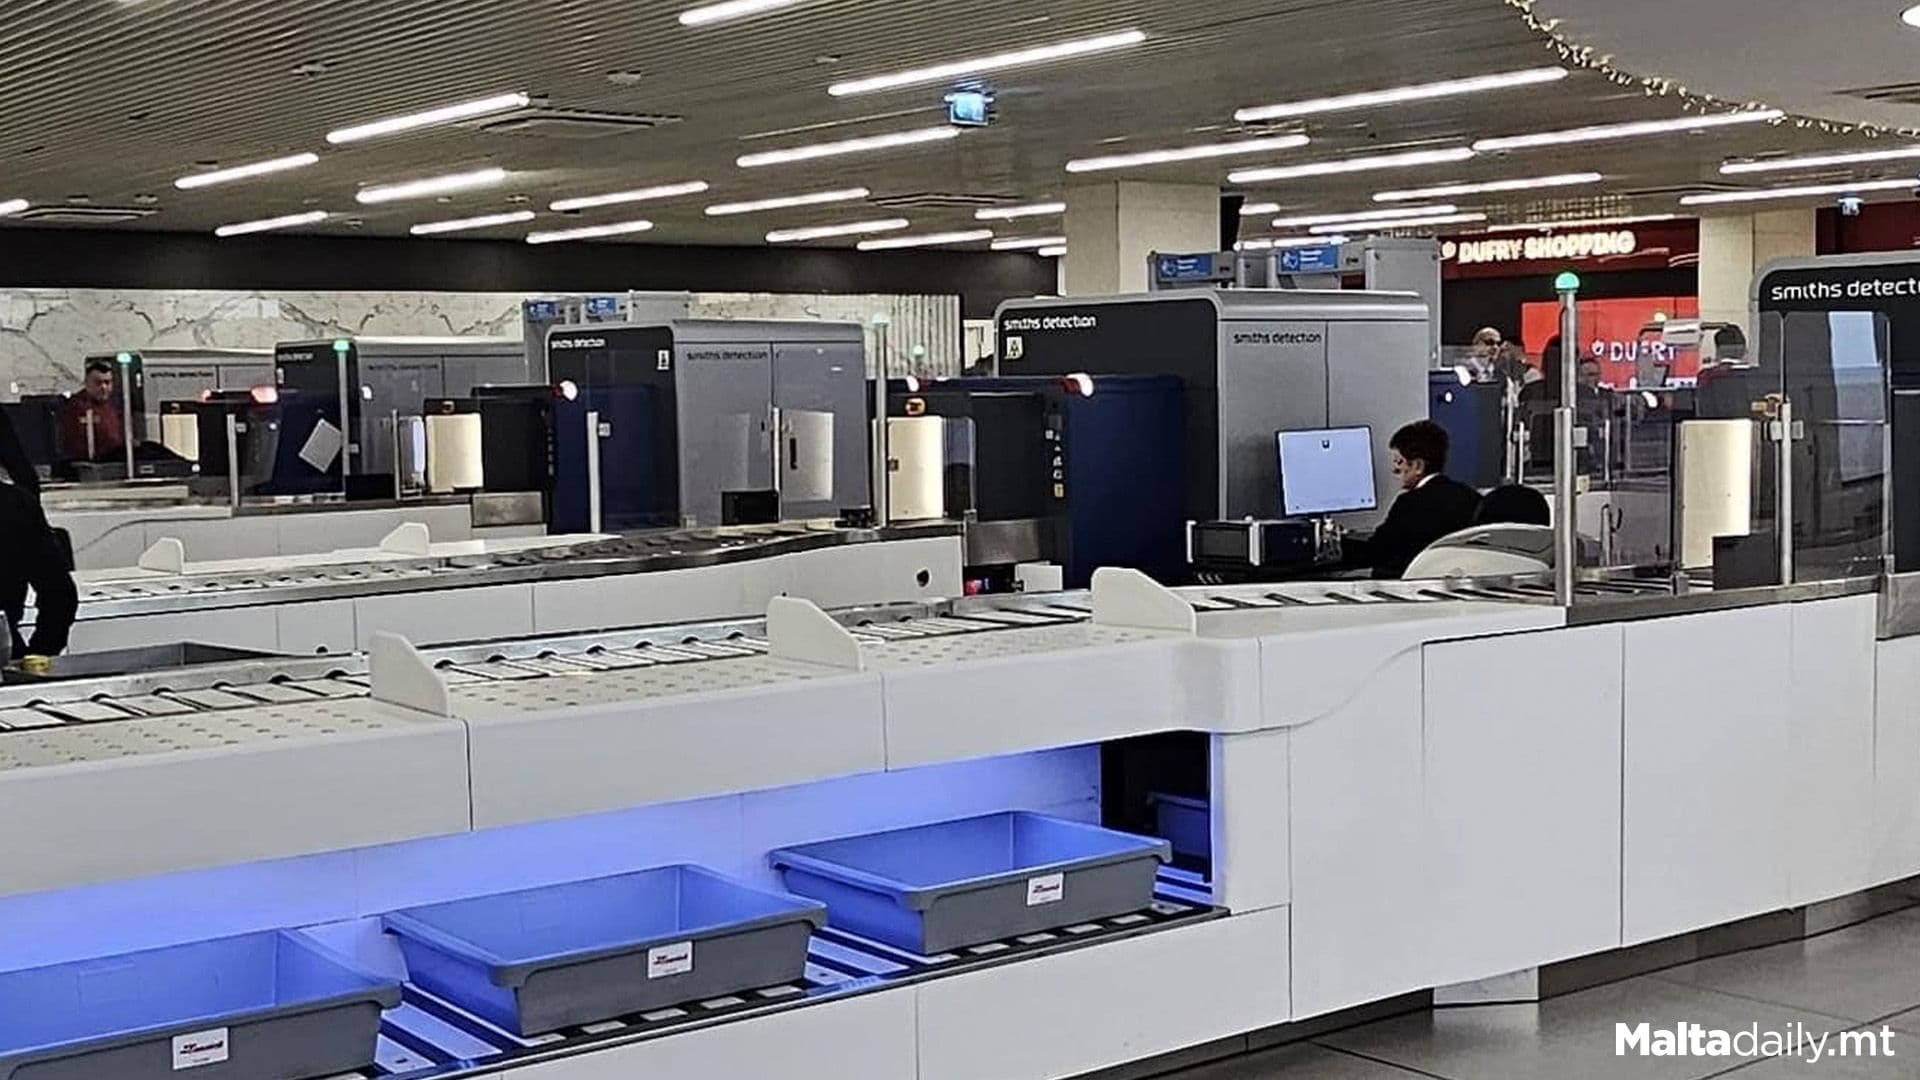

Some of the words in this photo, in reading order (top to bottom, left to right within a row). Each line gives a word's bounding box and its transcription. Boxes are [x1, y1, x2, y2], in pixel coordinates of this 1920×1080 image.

[1458, 239, 1523, 264] DUFRY
[1524, 229, 1636, 259] SHOPPING
[1771, 280, 1842, 300] smiths
[1003, 318, 1041, 330] smiths
[1042, 315, 1097, 329] detection
